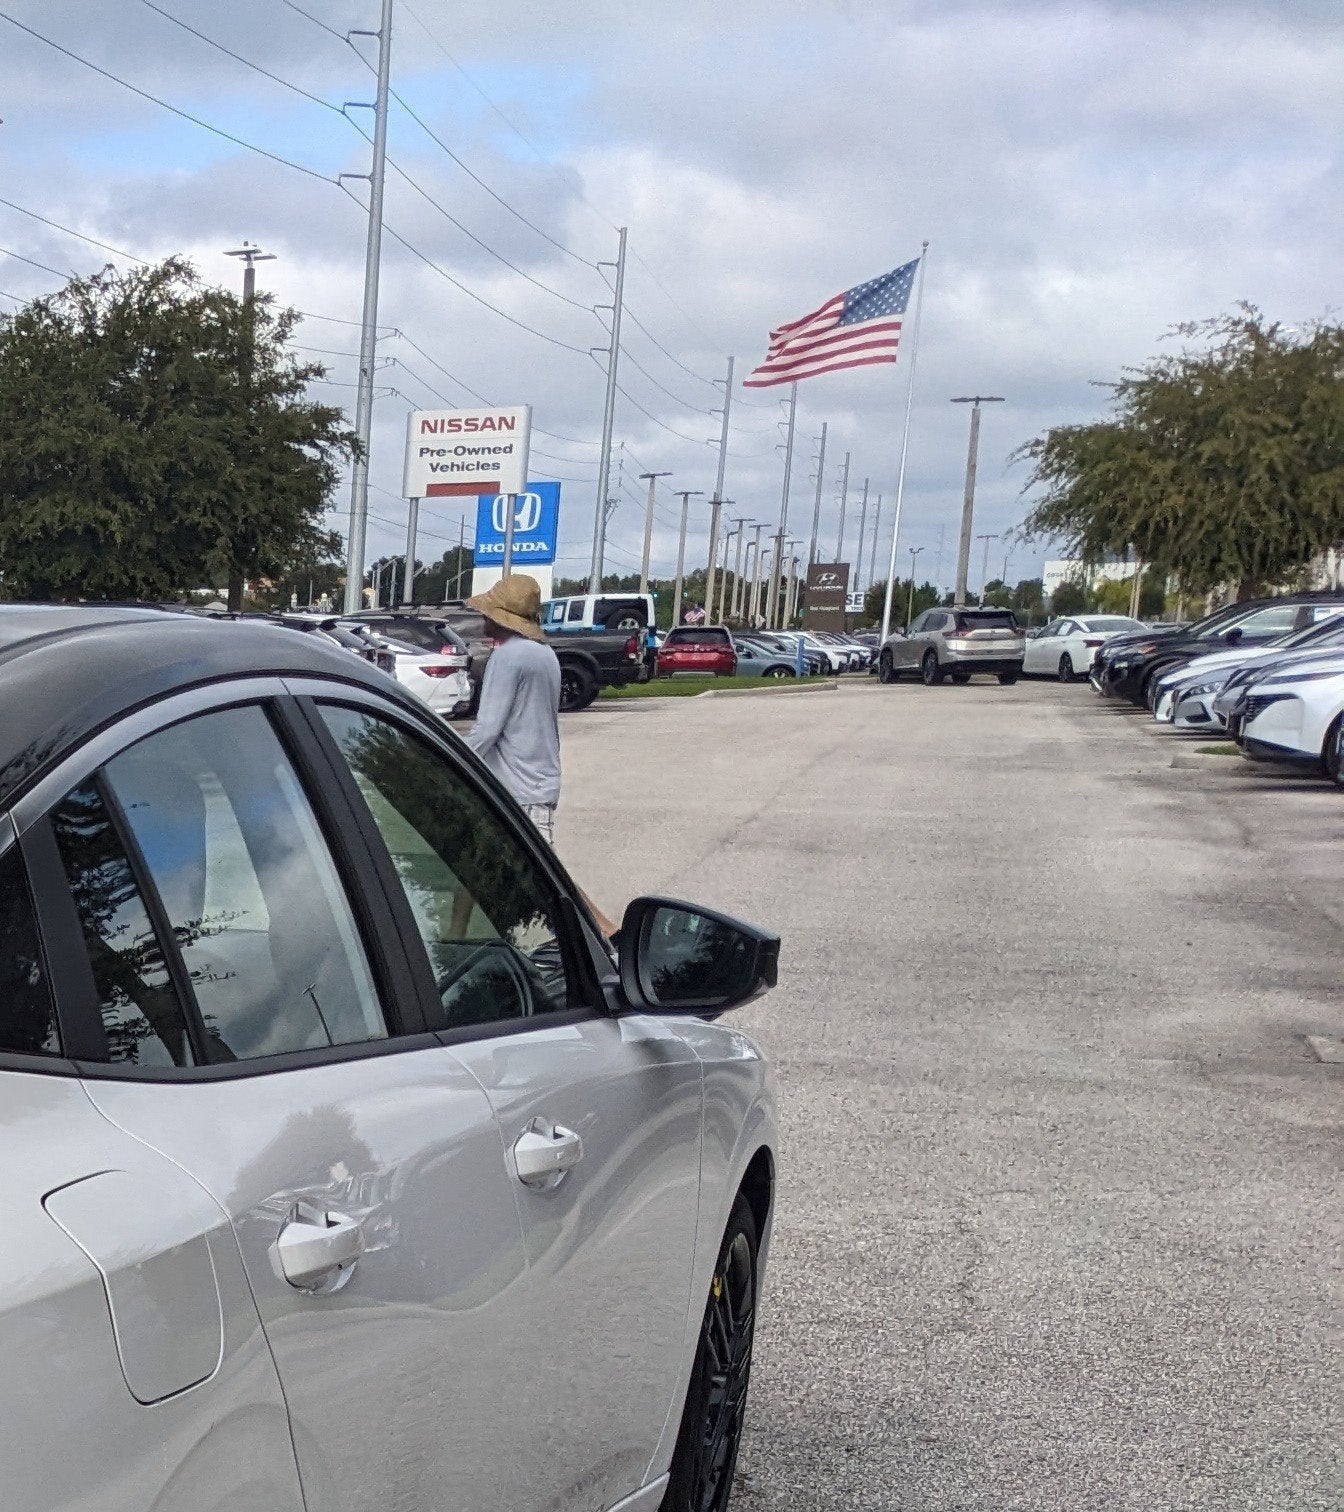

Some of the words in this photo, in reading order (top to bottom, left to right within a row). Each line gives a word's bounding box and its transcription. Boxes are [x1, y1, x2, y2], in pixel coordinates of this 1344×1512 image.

[420, 416, 516, 435] NISSAN
[419, 443, 514, 458] Pre-Owned
[429, 460, 501, 473] Vehicles
[478, 541, 549, 554] HONDA
